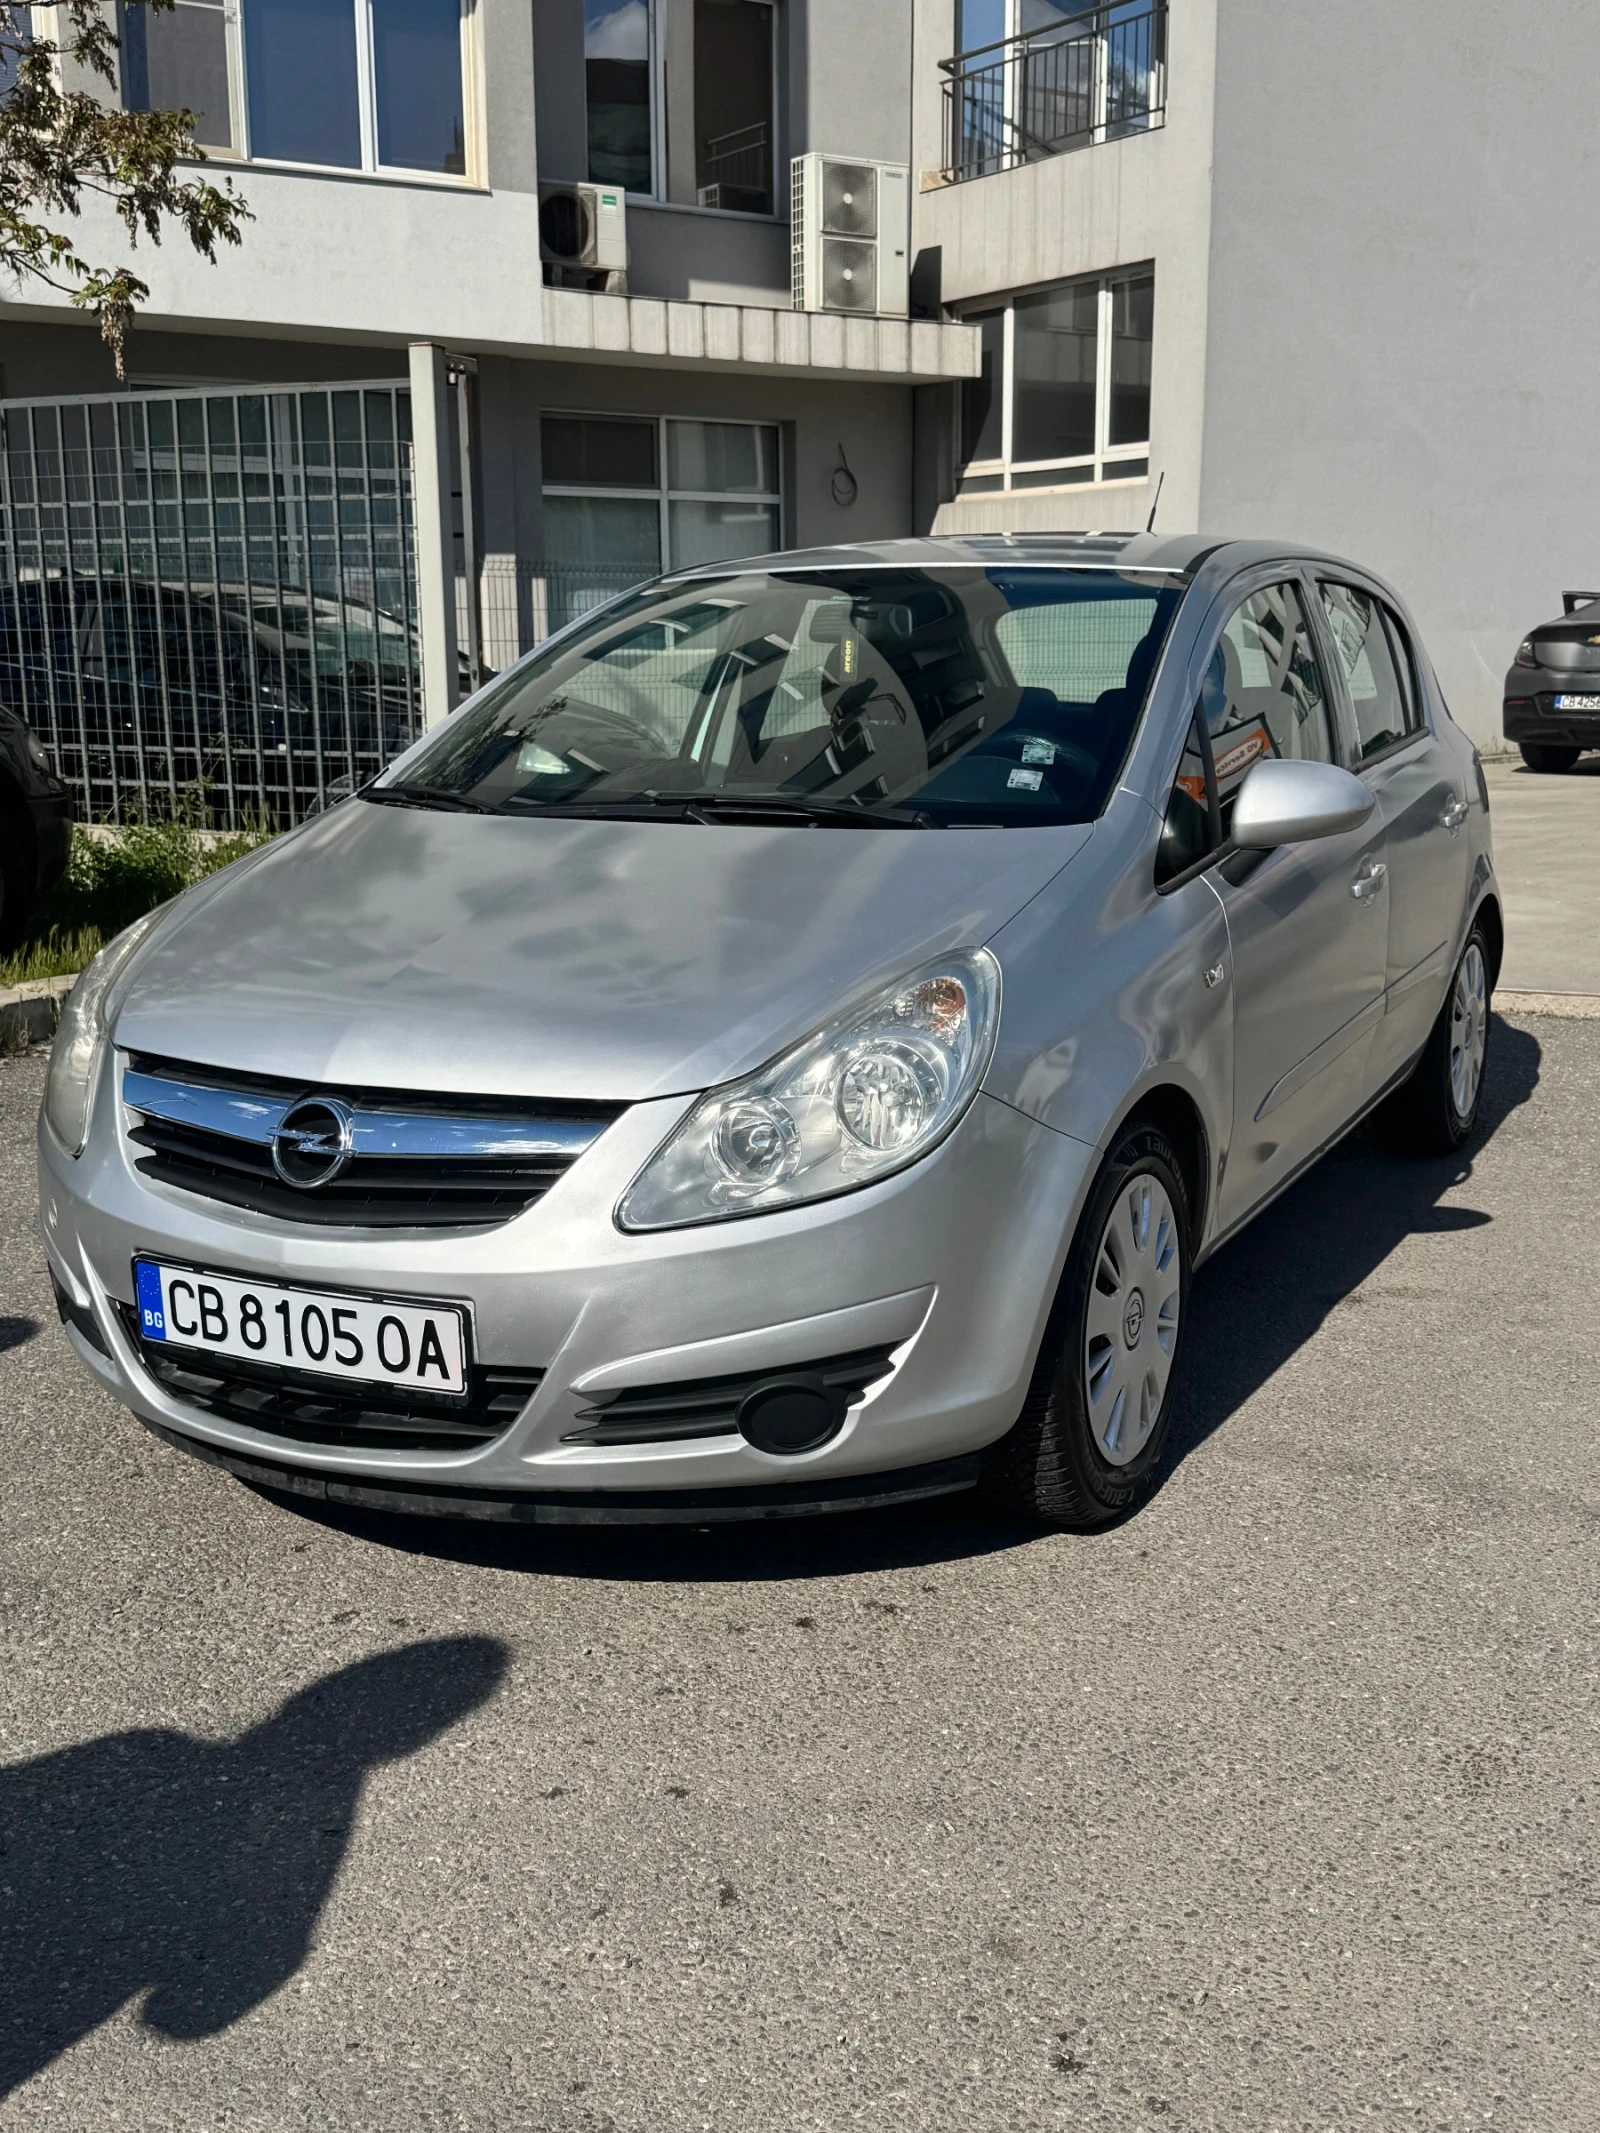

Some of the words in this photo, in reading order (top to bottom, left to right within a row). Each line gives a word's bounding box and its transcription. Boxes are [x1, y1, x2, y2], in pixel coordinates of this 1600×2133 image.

[144, 1309, 164, 1329] BG
[168, 1279, 228, 1342] CB
[239, 1293, 364, 1367] 8105
[377, 1315, 451, 1380] OA
